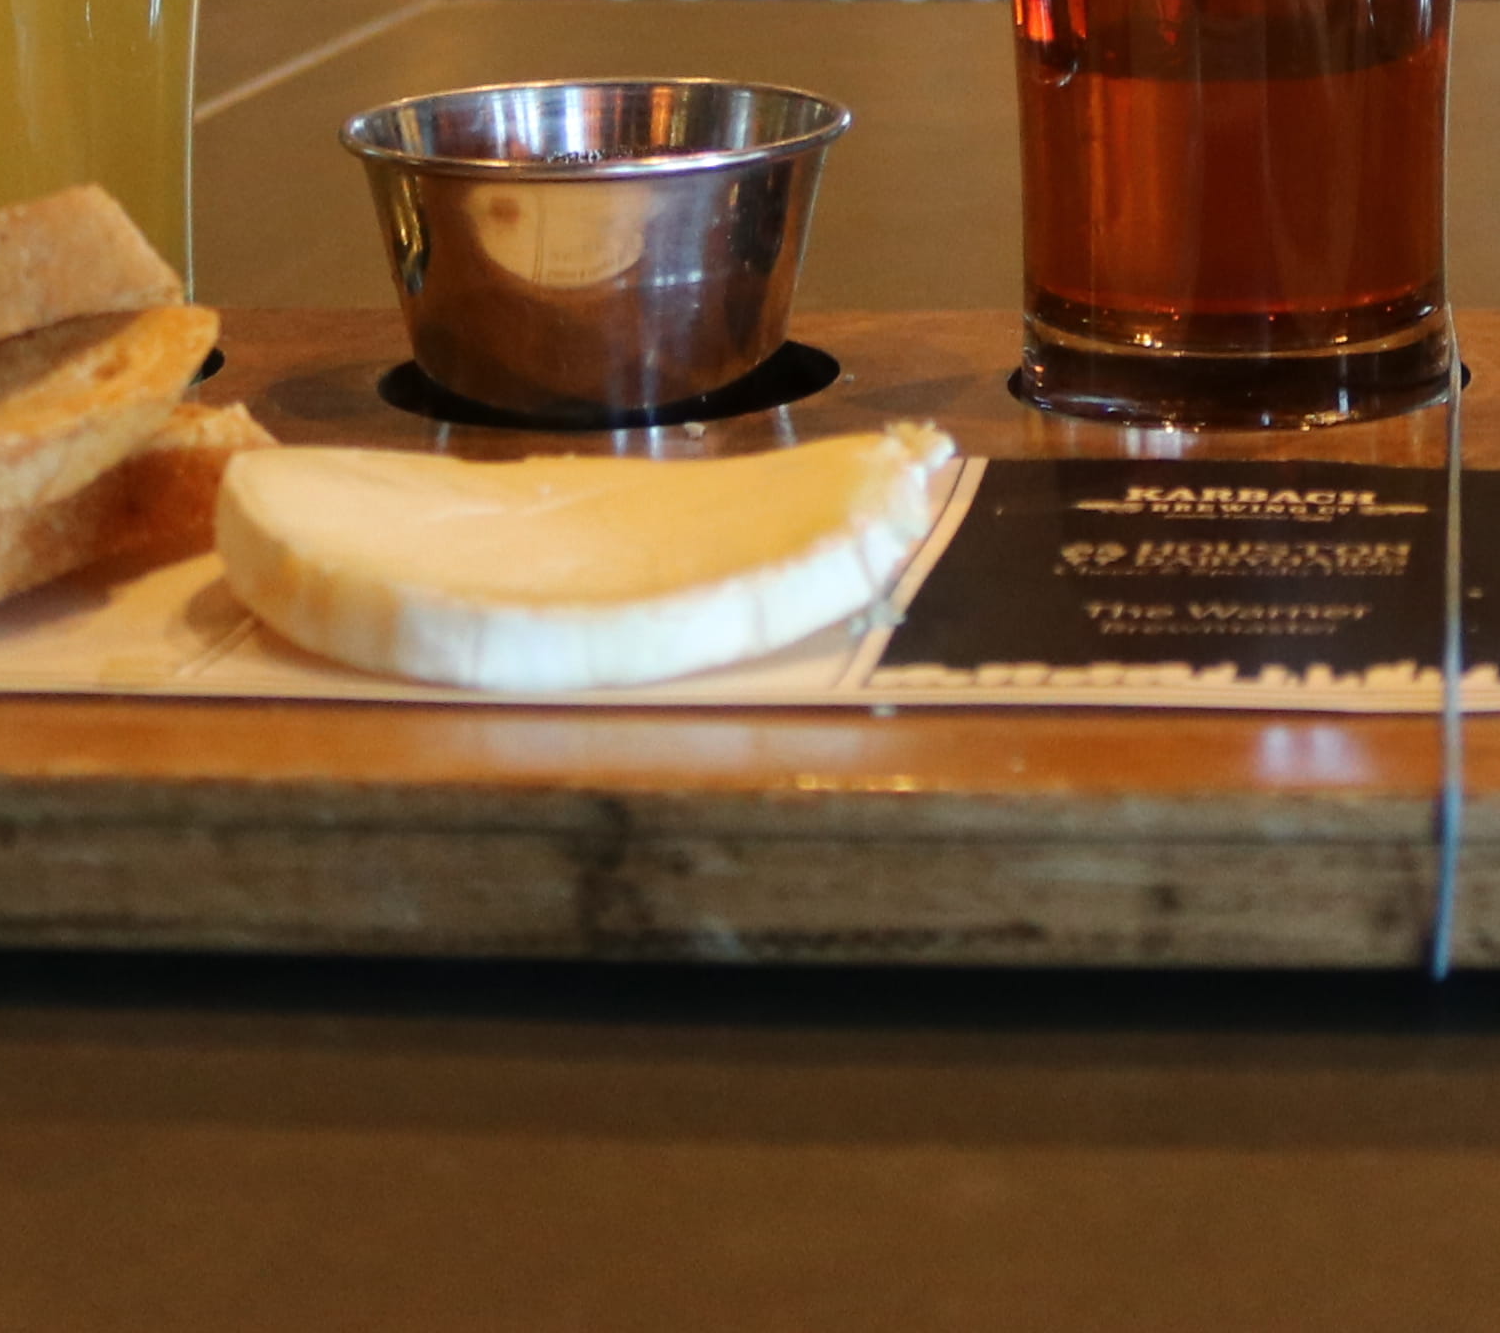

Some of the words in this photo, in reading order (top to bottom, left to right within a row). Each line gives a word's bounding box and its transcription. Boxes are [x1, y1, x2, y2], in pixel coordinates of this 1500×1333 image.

[1124, 485, 1378, 506] KARBACH
[1151, 503, 1310, 516] BREWING
[1084, 603, 1176, 620] The
